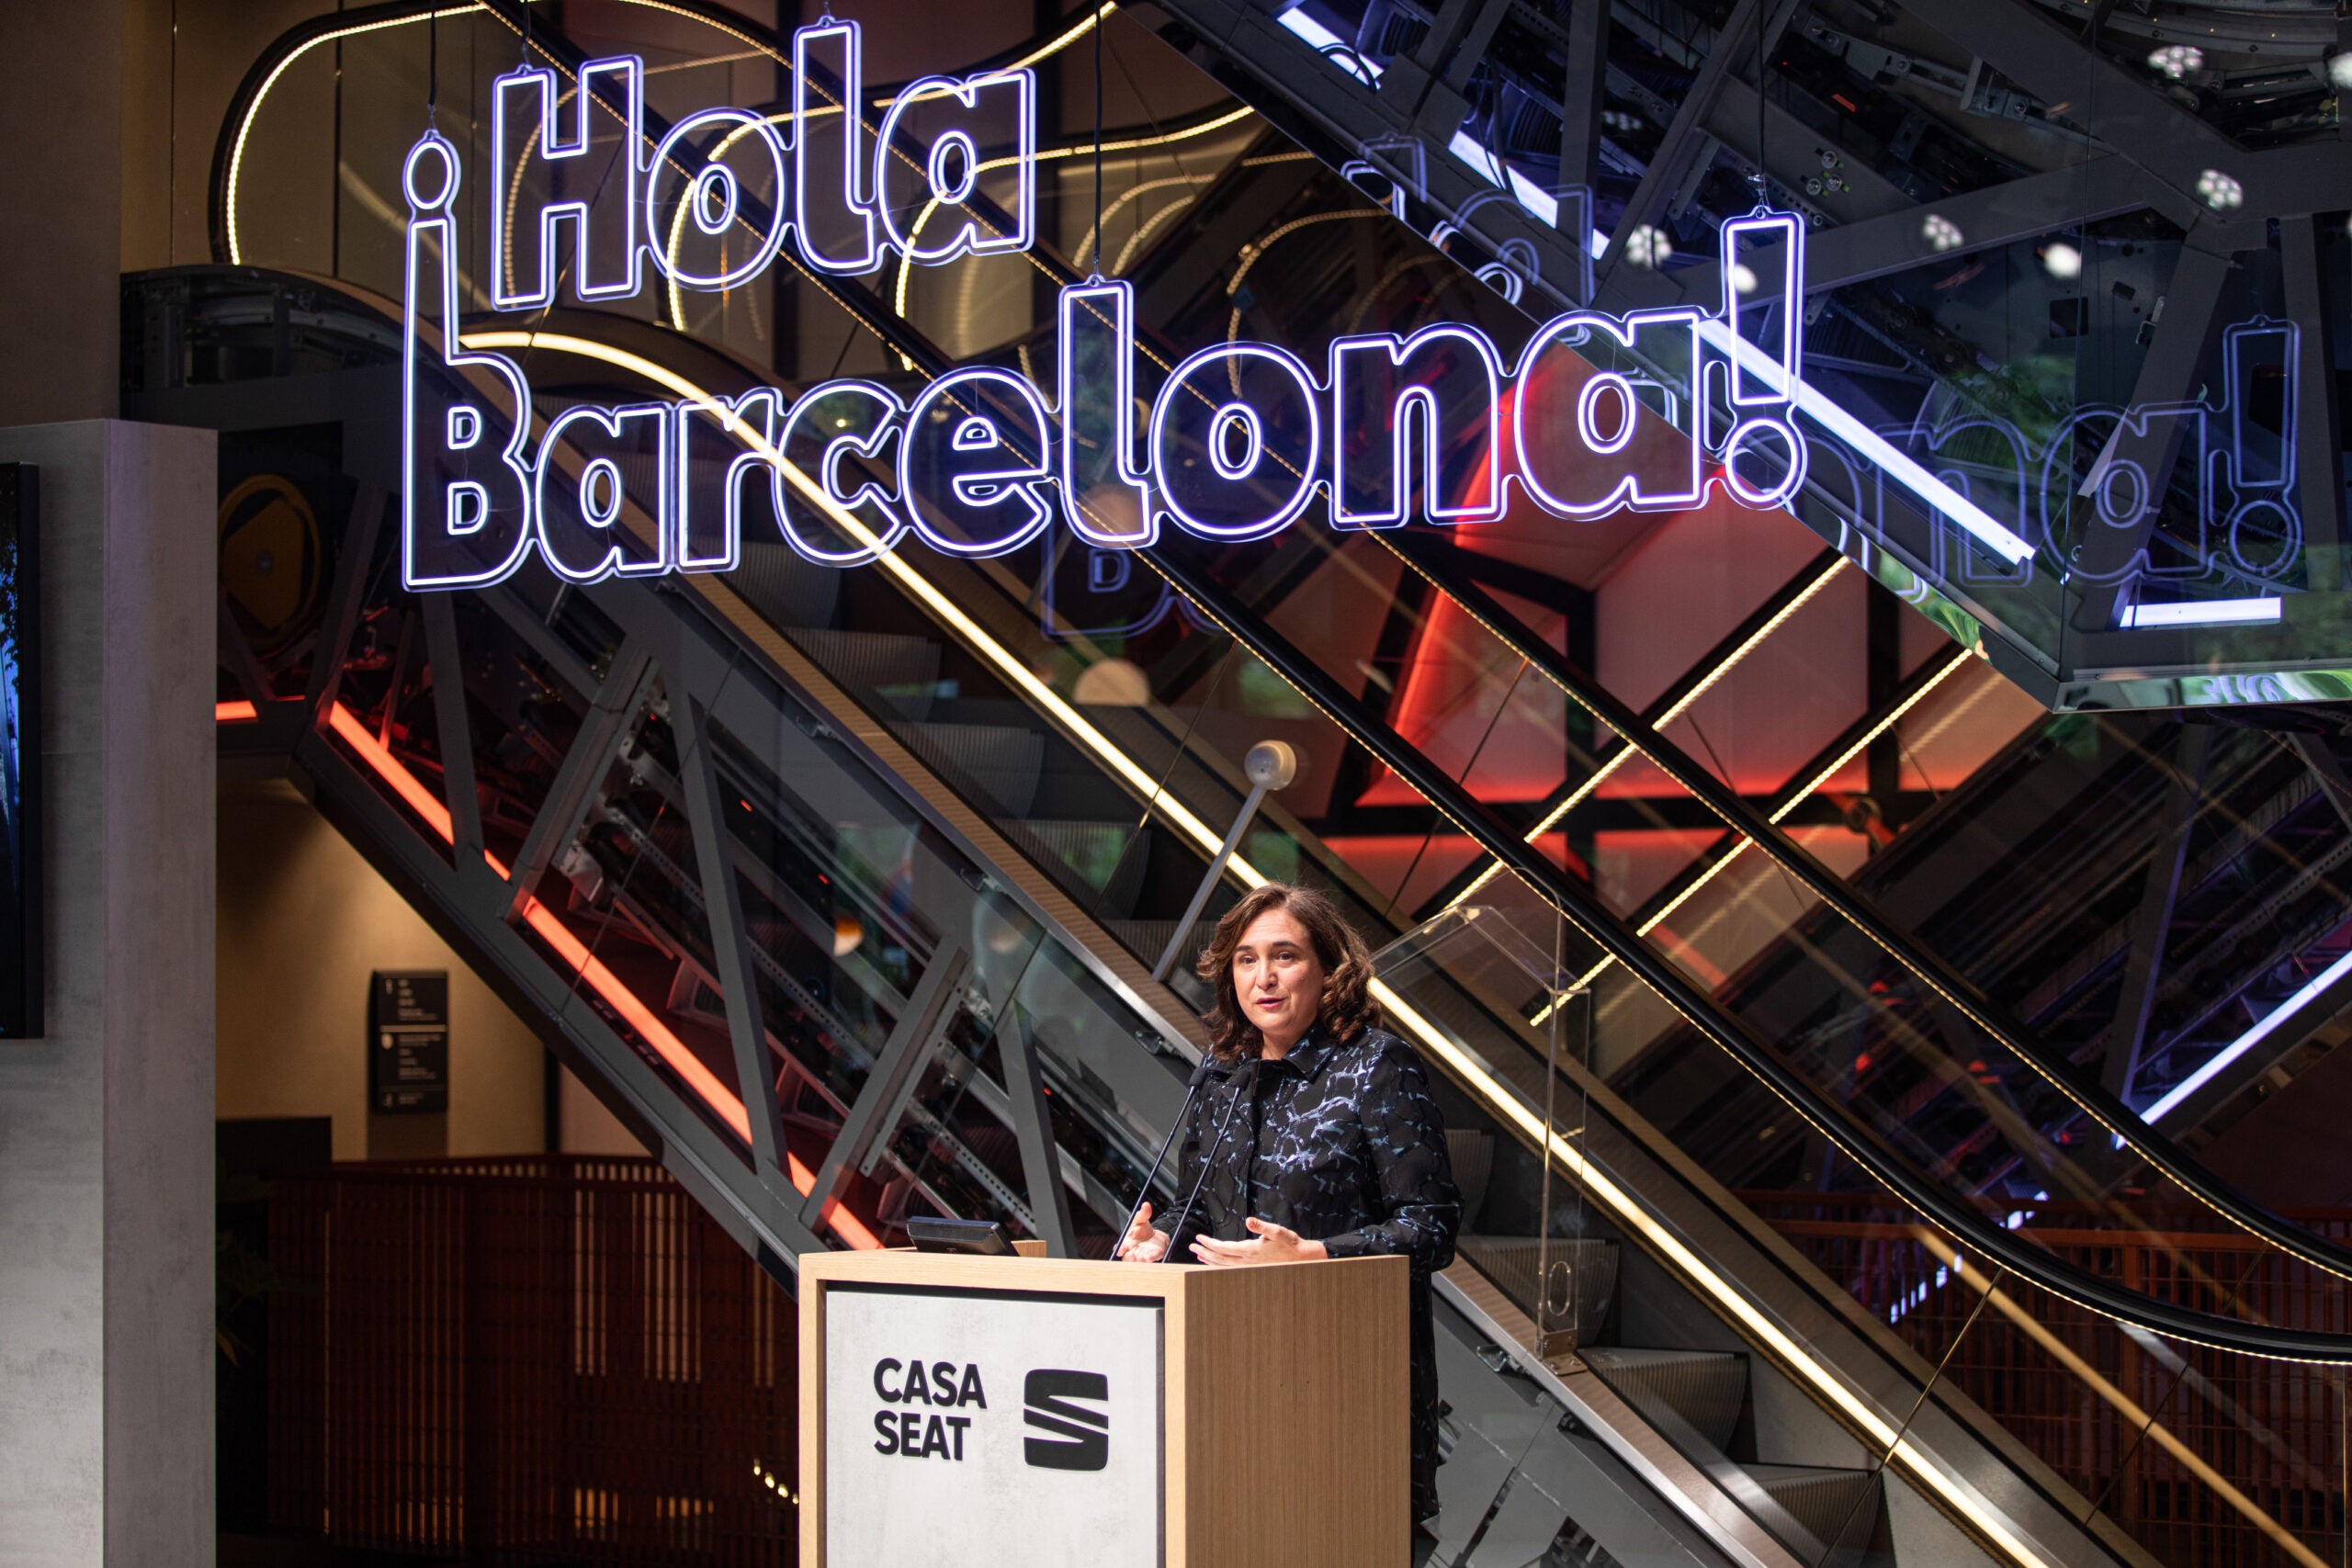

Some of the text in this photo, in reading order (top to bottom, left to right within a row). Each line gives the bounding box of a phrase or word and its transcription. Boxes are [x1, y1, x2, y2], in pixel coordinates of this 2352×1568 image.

[402, 213, 1806, 591] Barcelona!
[873, 1357, 988, 1410] CASA
[873, 1409, 972, 1461] SEAT
